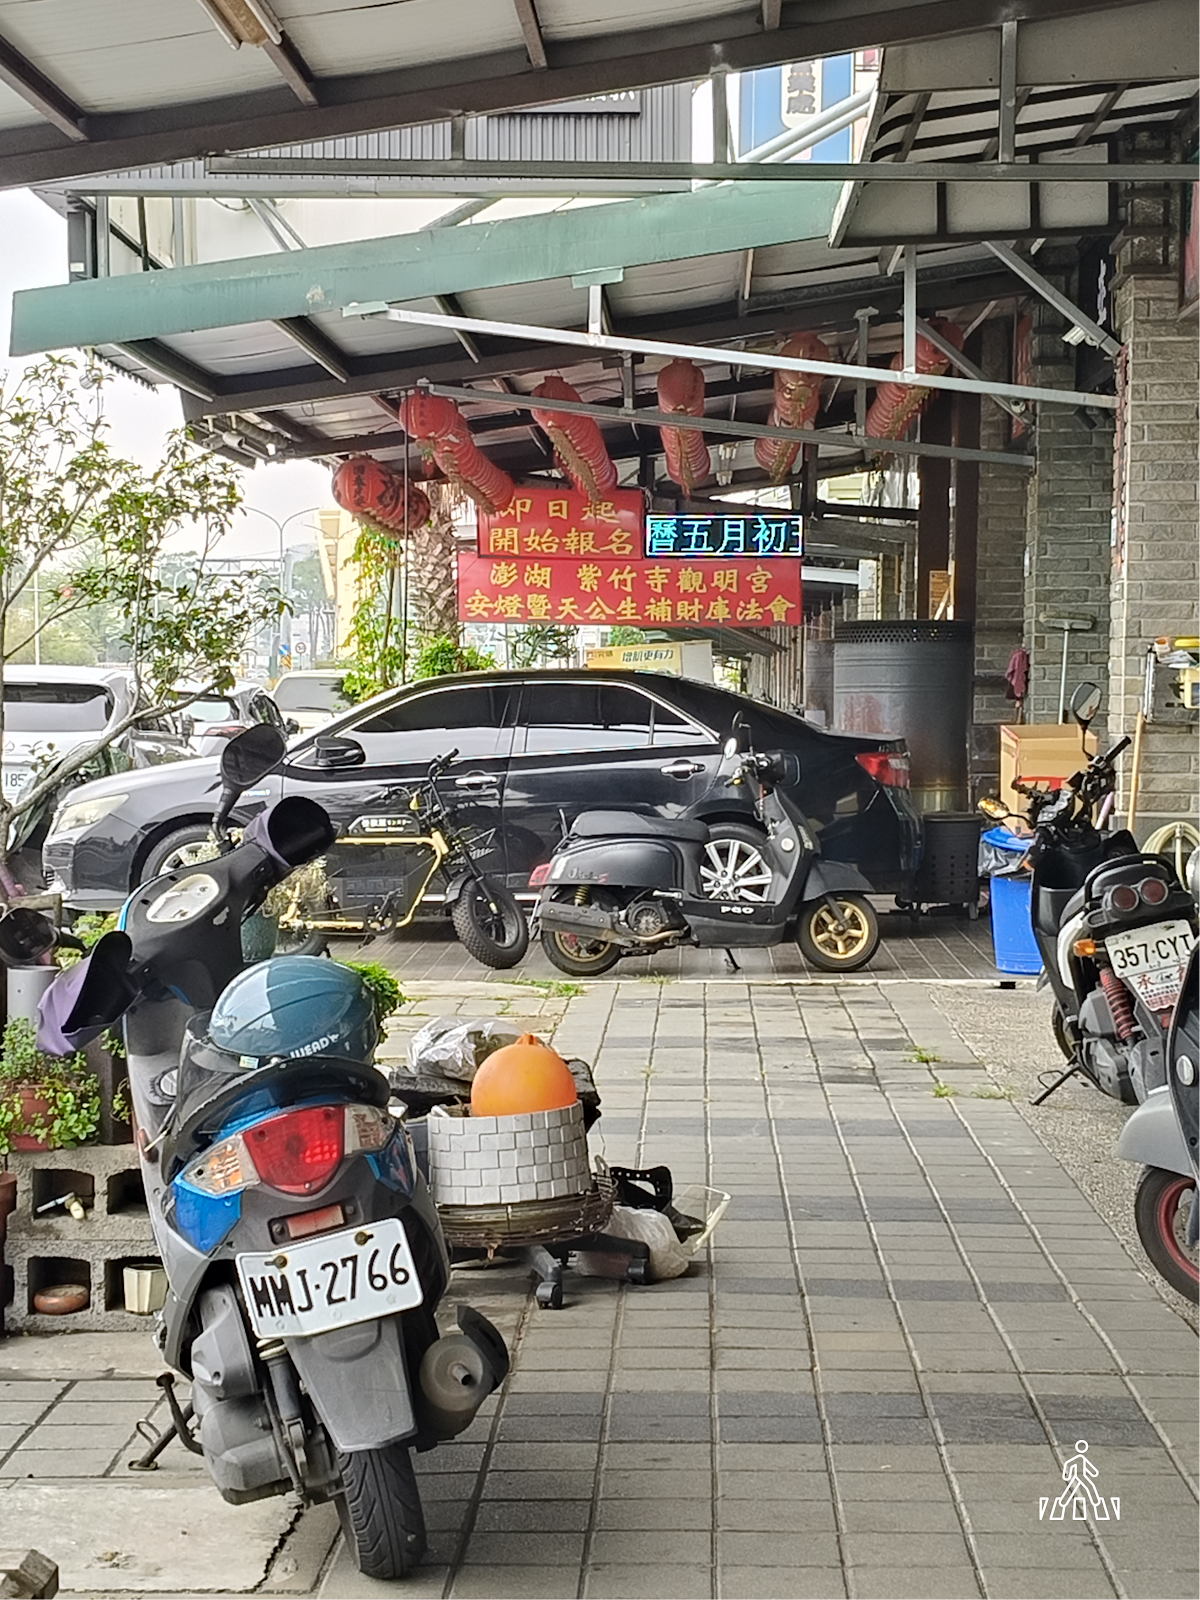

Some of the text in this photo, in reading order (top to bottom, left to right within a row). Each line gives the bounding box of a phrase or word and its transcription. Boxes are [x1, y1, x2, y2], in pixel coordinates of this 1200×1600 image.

[490, 527, 634, 556] 開始報名
[490, 561, 774, 594] 澎湖 紫竹寺觀明宮
[464, 589, 797, 624] 安燈暨天公生補財庫法會
[622, 649, 674, 662] 增肌更有力
[720, 905, 755, 915] PGO
